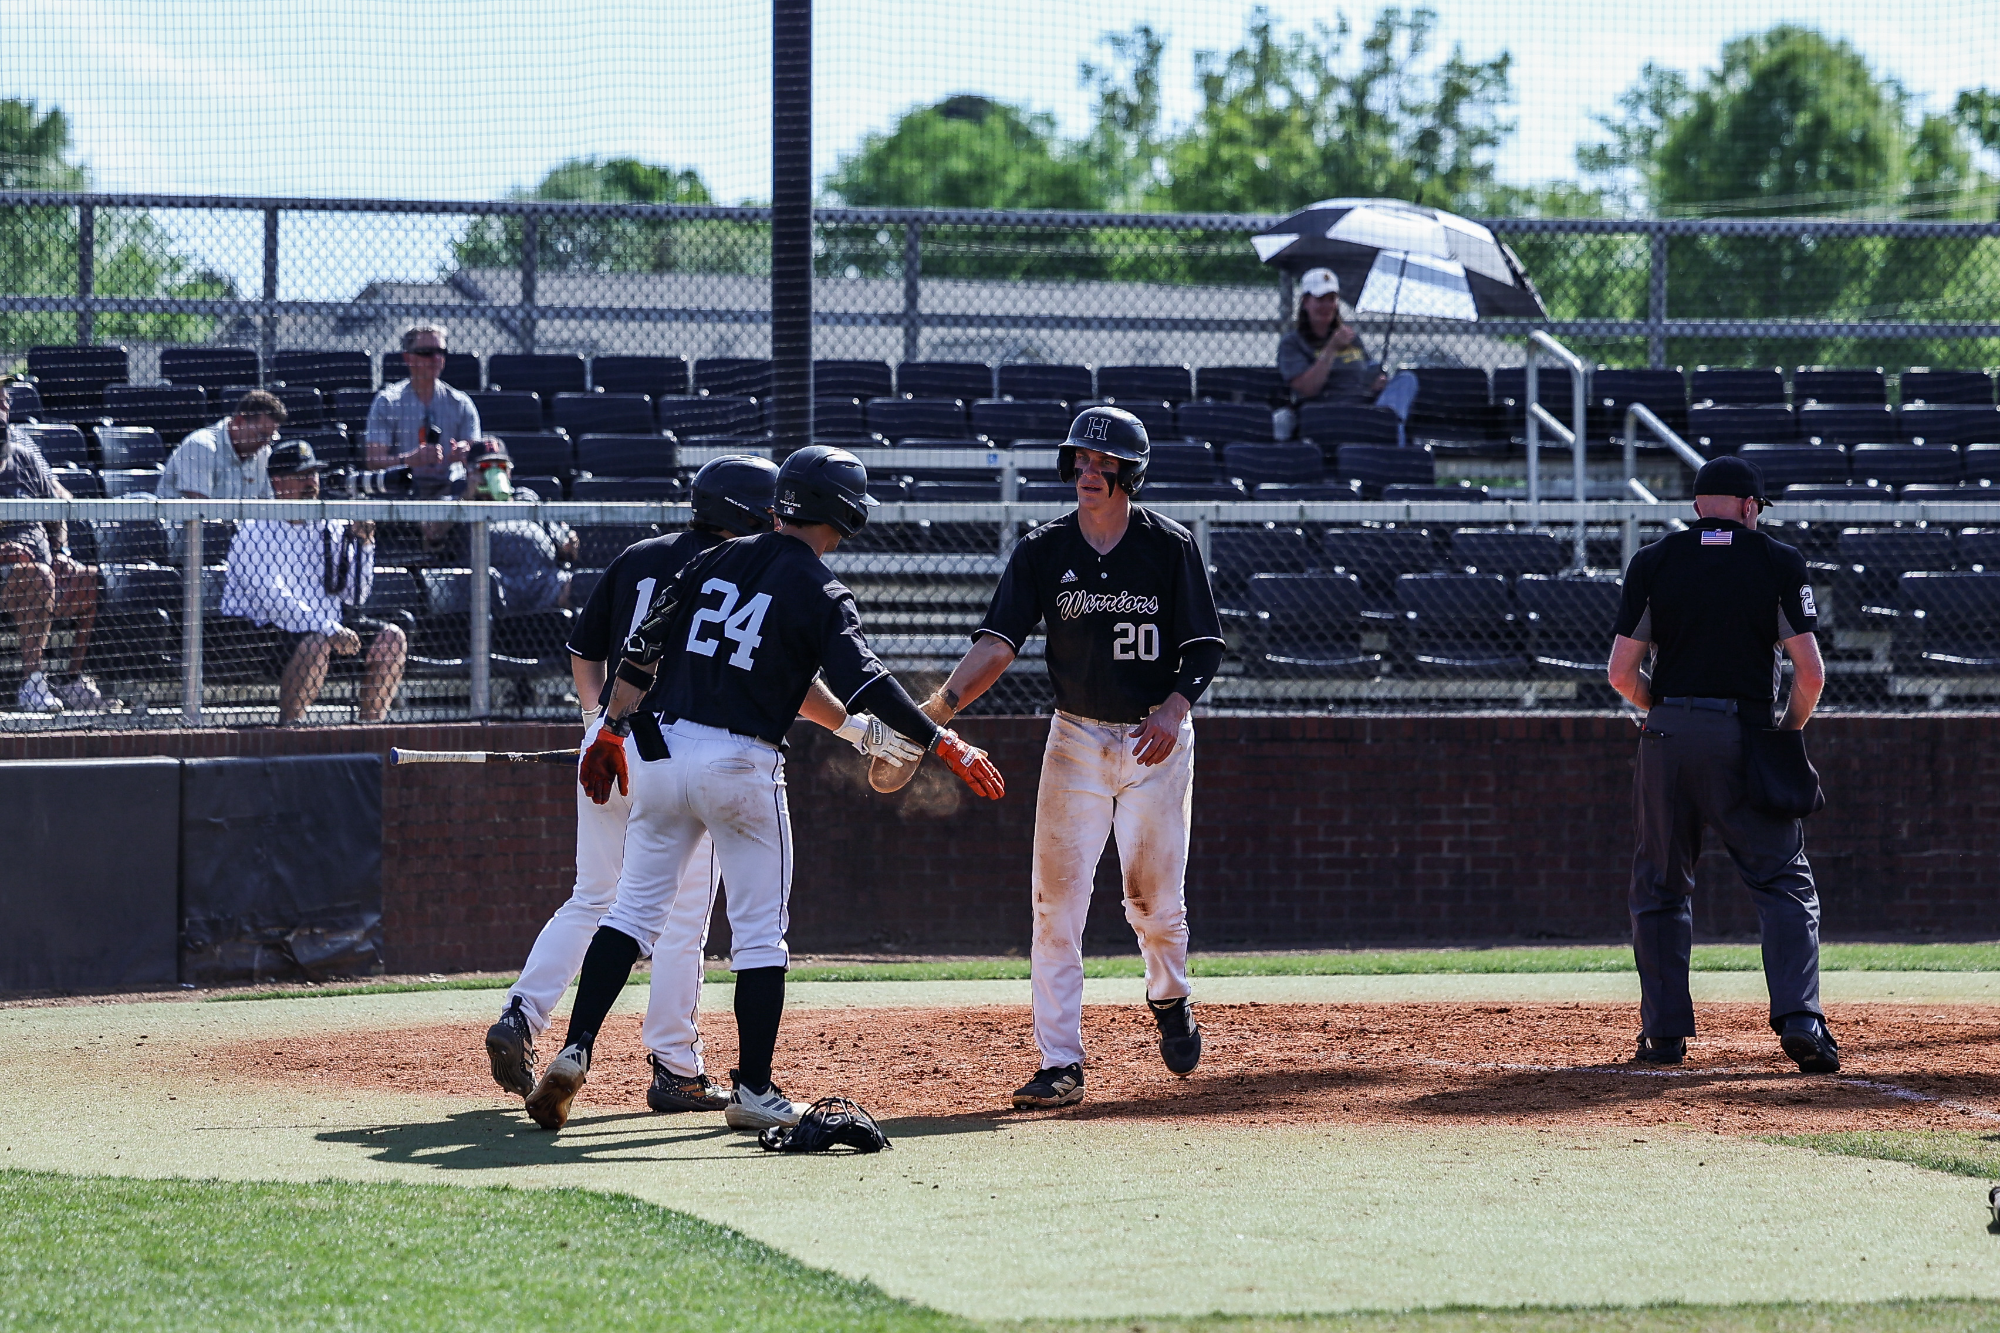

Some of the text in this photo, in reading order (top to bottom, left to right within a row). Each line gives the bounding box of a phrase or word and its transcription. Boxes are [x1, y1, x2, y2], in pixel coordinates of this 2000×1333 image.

[1084, 416, 1112, 441] H
[1056, 589, 1159, 620] Warriors
[686, 577, 773, 672] 24
[1113, 622, 1160, 661] 20
